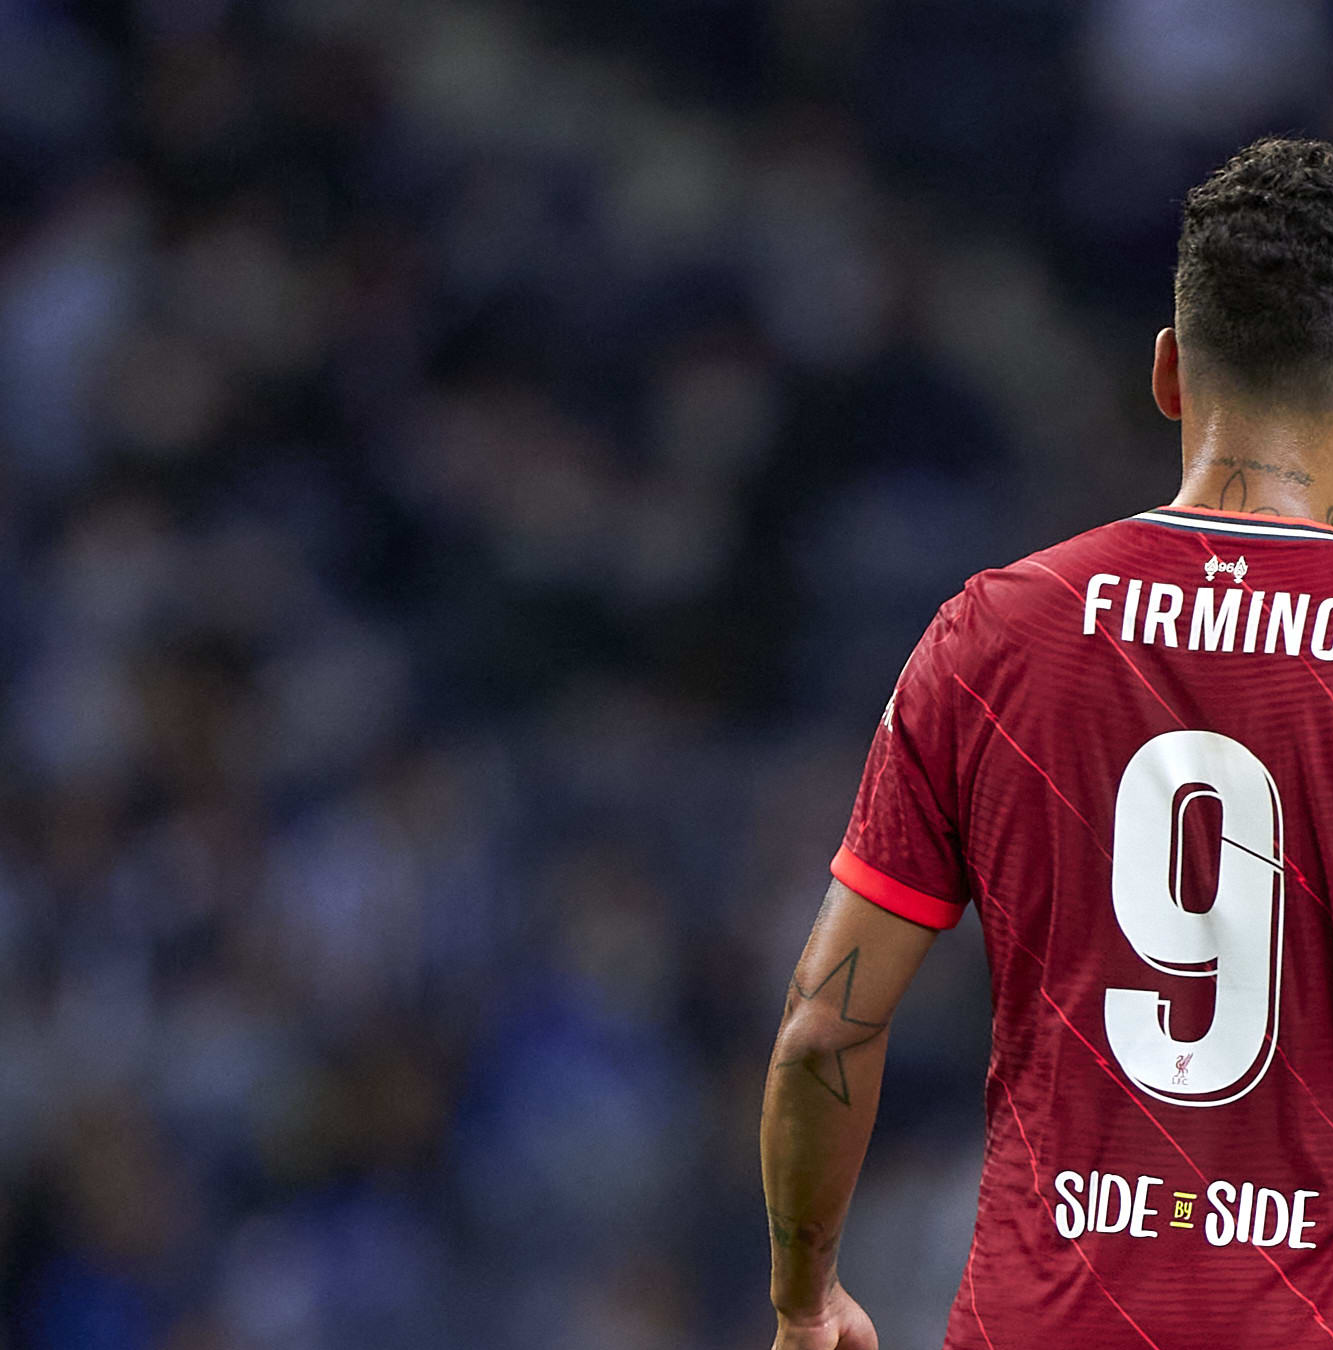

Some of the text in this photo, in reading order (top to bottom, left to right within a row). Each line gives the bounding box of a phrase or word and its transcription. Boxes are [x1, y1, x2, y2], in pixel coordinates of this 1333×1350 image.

[1104, 730, 1284, 1107] 9
[1054, 1170, 1164, 1239] SIDE
[1205, 1180, 1320, 1249] SIDE
